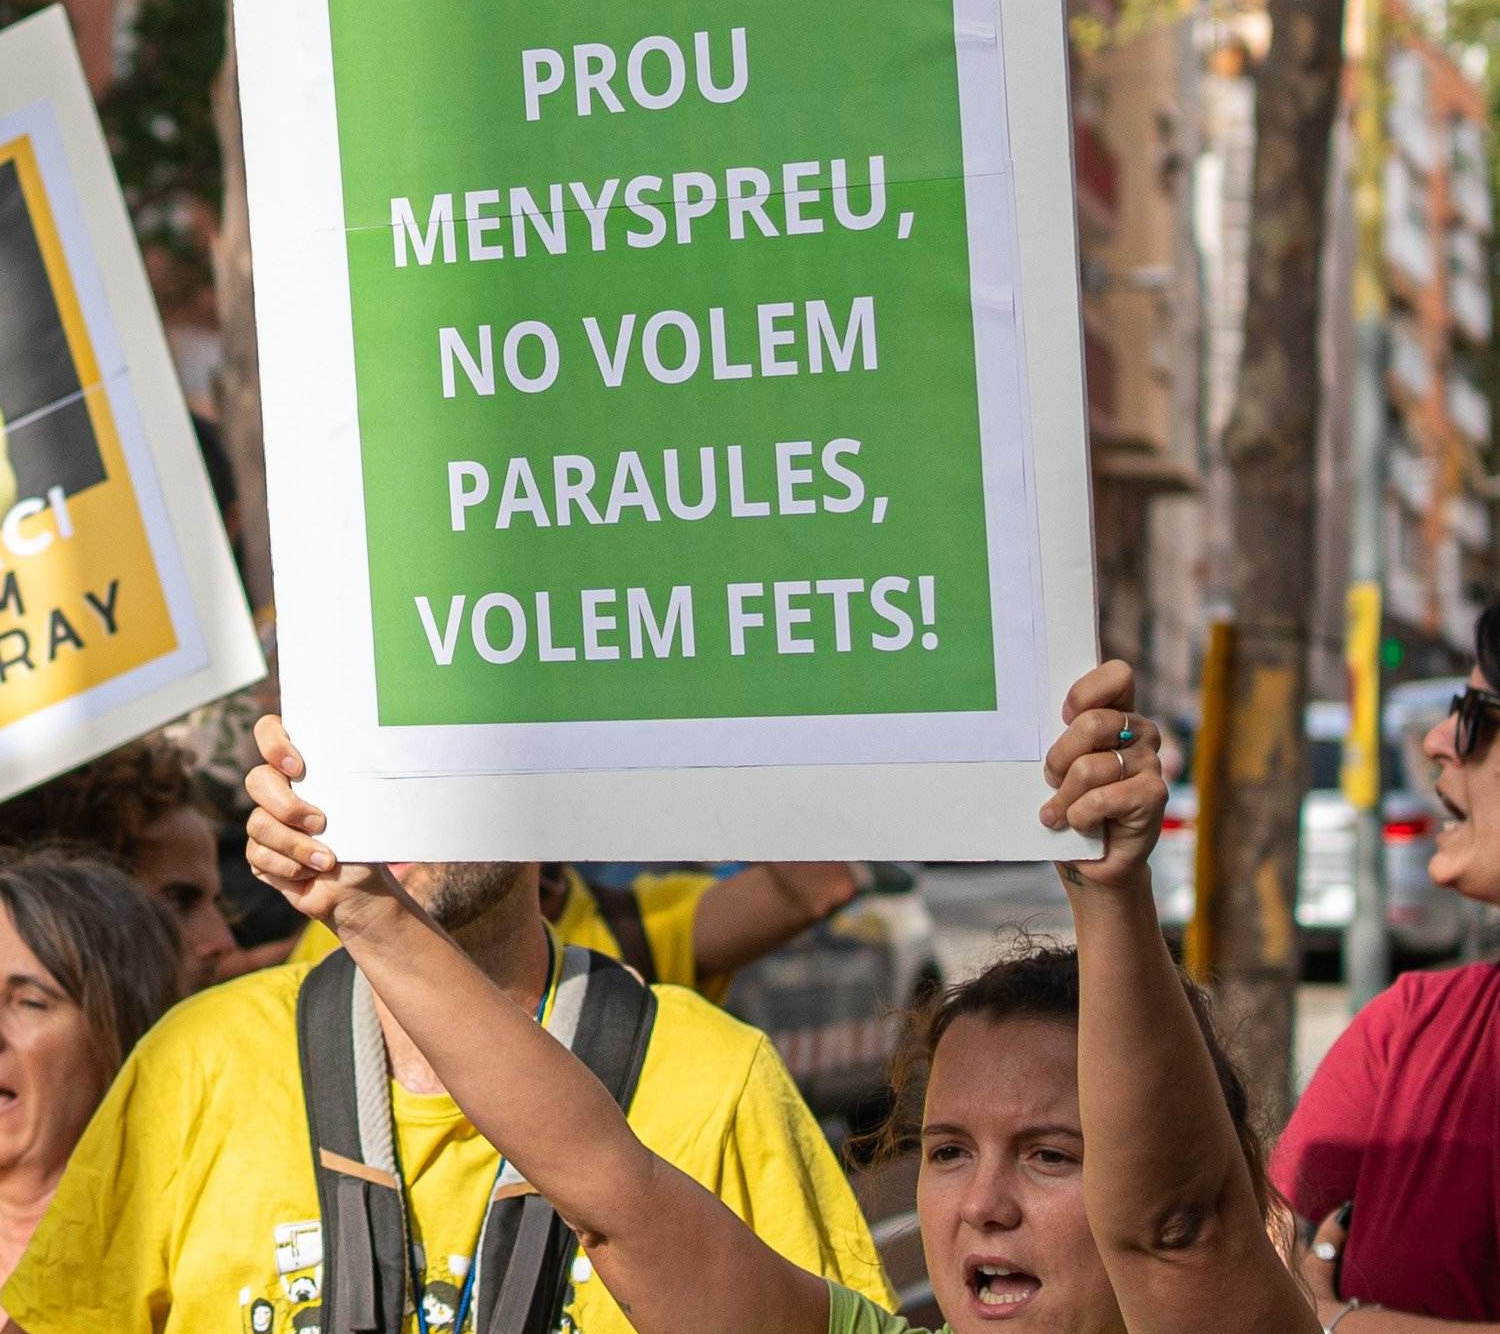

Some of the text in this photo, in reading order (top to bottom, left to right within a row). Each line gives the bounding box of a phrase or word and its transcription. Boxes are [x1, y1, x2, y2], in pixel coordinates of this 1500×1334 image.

[521, 28, 750, 122] PROU
[391, 156, 915, 268] MENYSPREU,
[439, 296, 879, 399] NO VOLEM
[447, 439, 891, 533] PARAULES,
[414, 576, 940, 667] VOLEM FETS!
